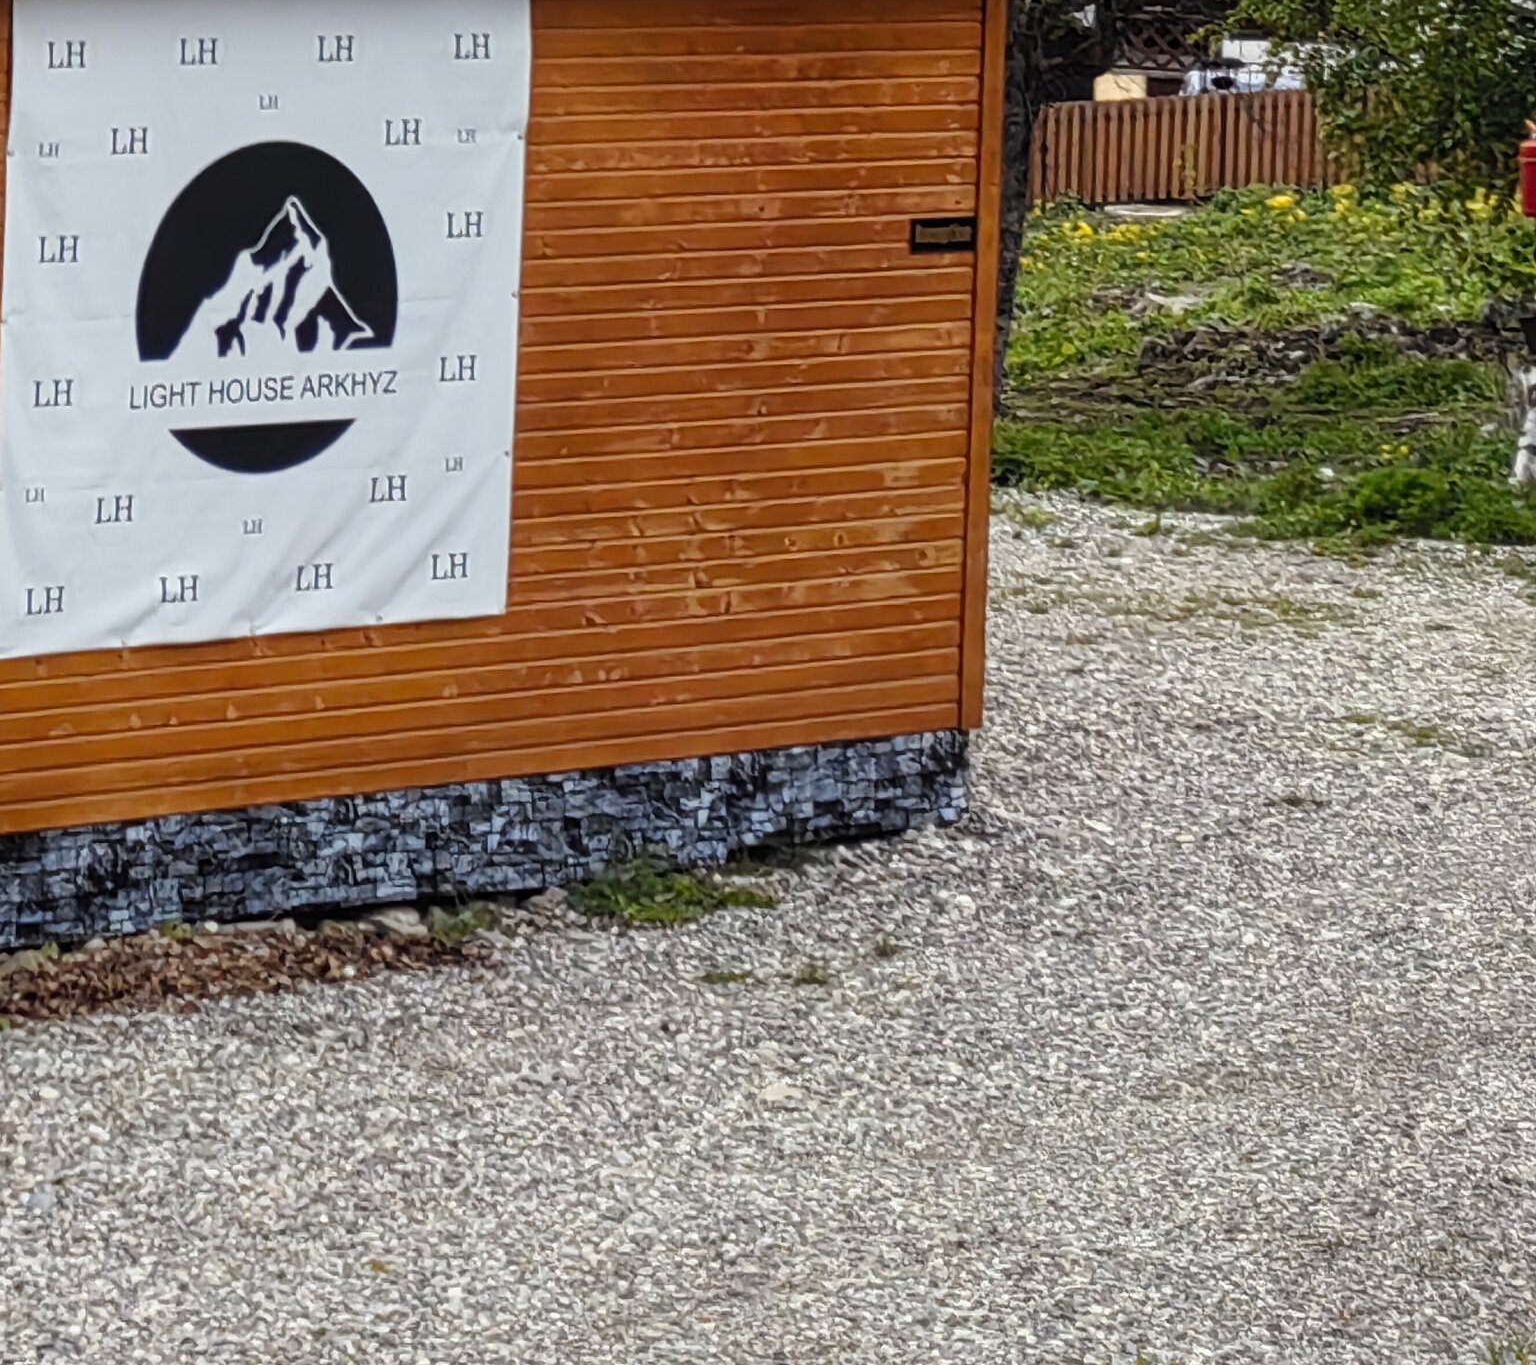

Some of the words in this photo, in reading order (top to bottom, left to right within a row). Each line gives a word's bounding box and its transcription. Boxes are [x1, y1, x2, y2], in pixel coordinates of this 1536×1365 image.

[47, 40, 87, 69] LH
[180, 37, 218, 66] LH
[317, 34, 355, 63] LH
[453, 32, 491, 60] LH
[111, 126, 148, 156] LH
[385, 118, 422, 147] LH
[446, 210, 484, 239] LH
[38, 234, 79, 264] LH
[439, 354, 478, 383] LH
[33, 378, 74, 408] LH
[129, 381, 203, 410] LIGHT
[208, 375, 295, 405] HOUSE
[300, 370, 398, 399] ARKHYZ
[369, 474, 407, 504] LH
[95, 494, 134, 525] LH
[295, 562, 334, 592] LH
[431, 552, 468, 581] LH
[26, 585, 66, 616] LH
[159, 574, 200, 604] LH
